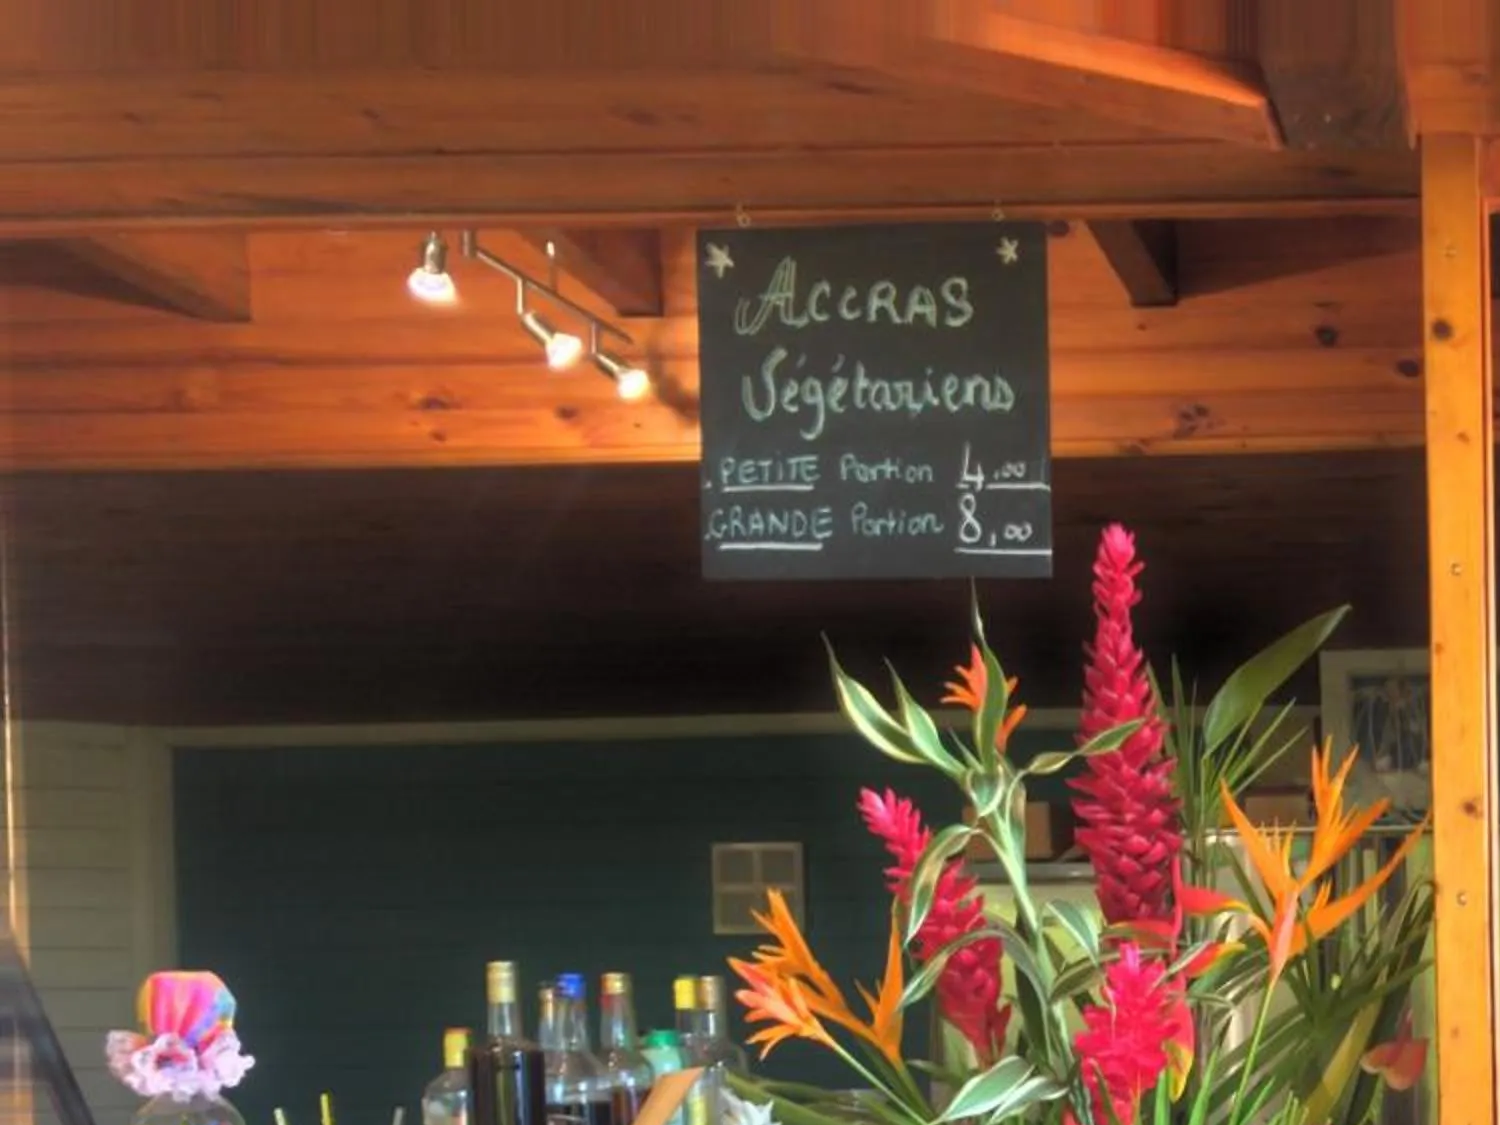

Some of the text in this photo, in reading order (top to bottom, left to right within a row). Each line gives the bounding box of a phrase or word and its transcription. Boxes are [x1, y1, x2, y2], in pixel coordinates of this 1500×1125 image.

[742, 348, 1015, 440] Végétariens
[840, 454, 934, 484] Portion
[708, 506, 834, 539] GRANDE
[852, 501, 945, 537] Portion
